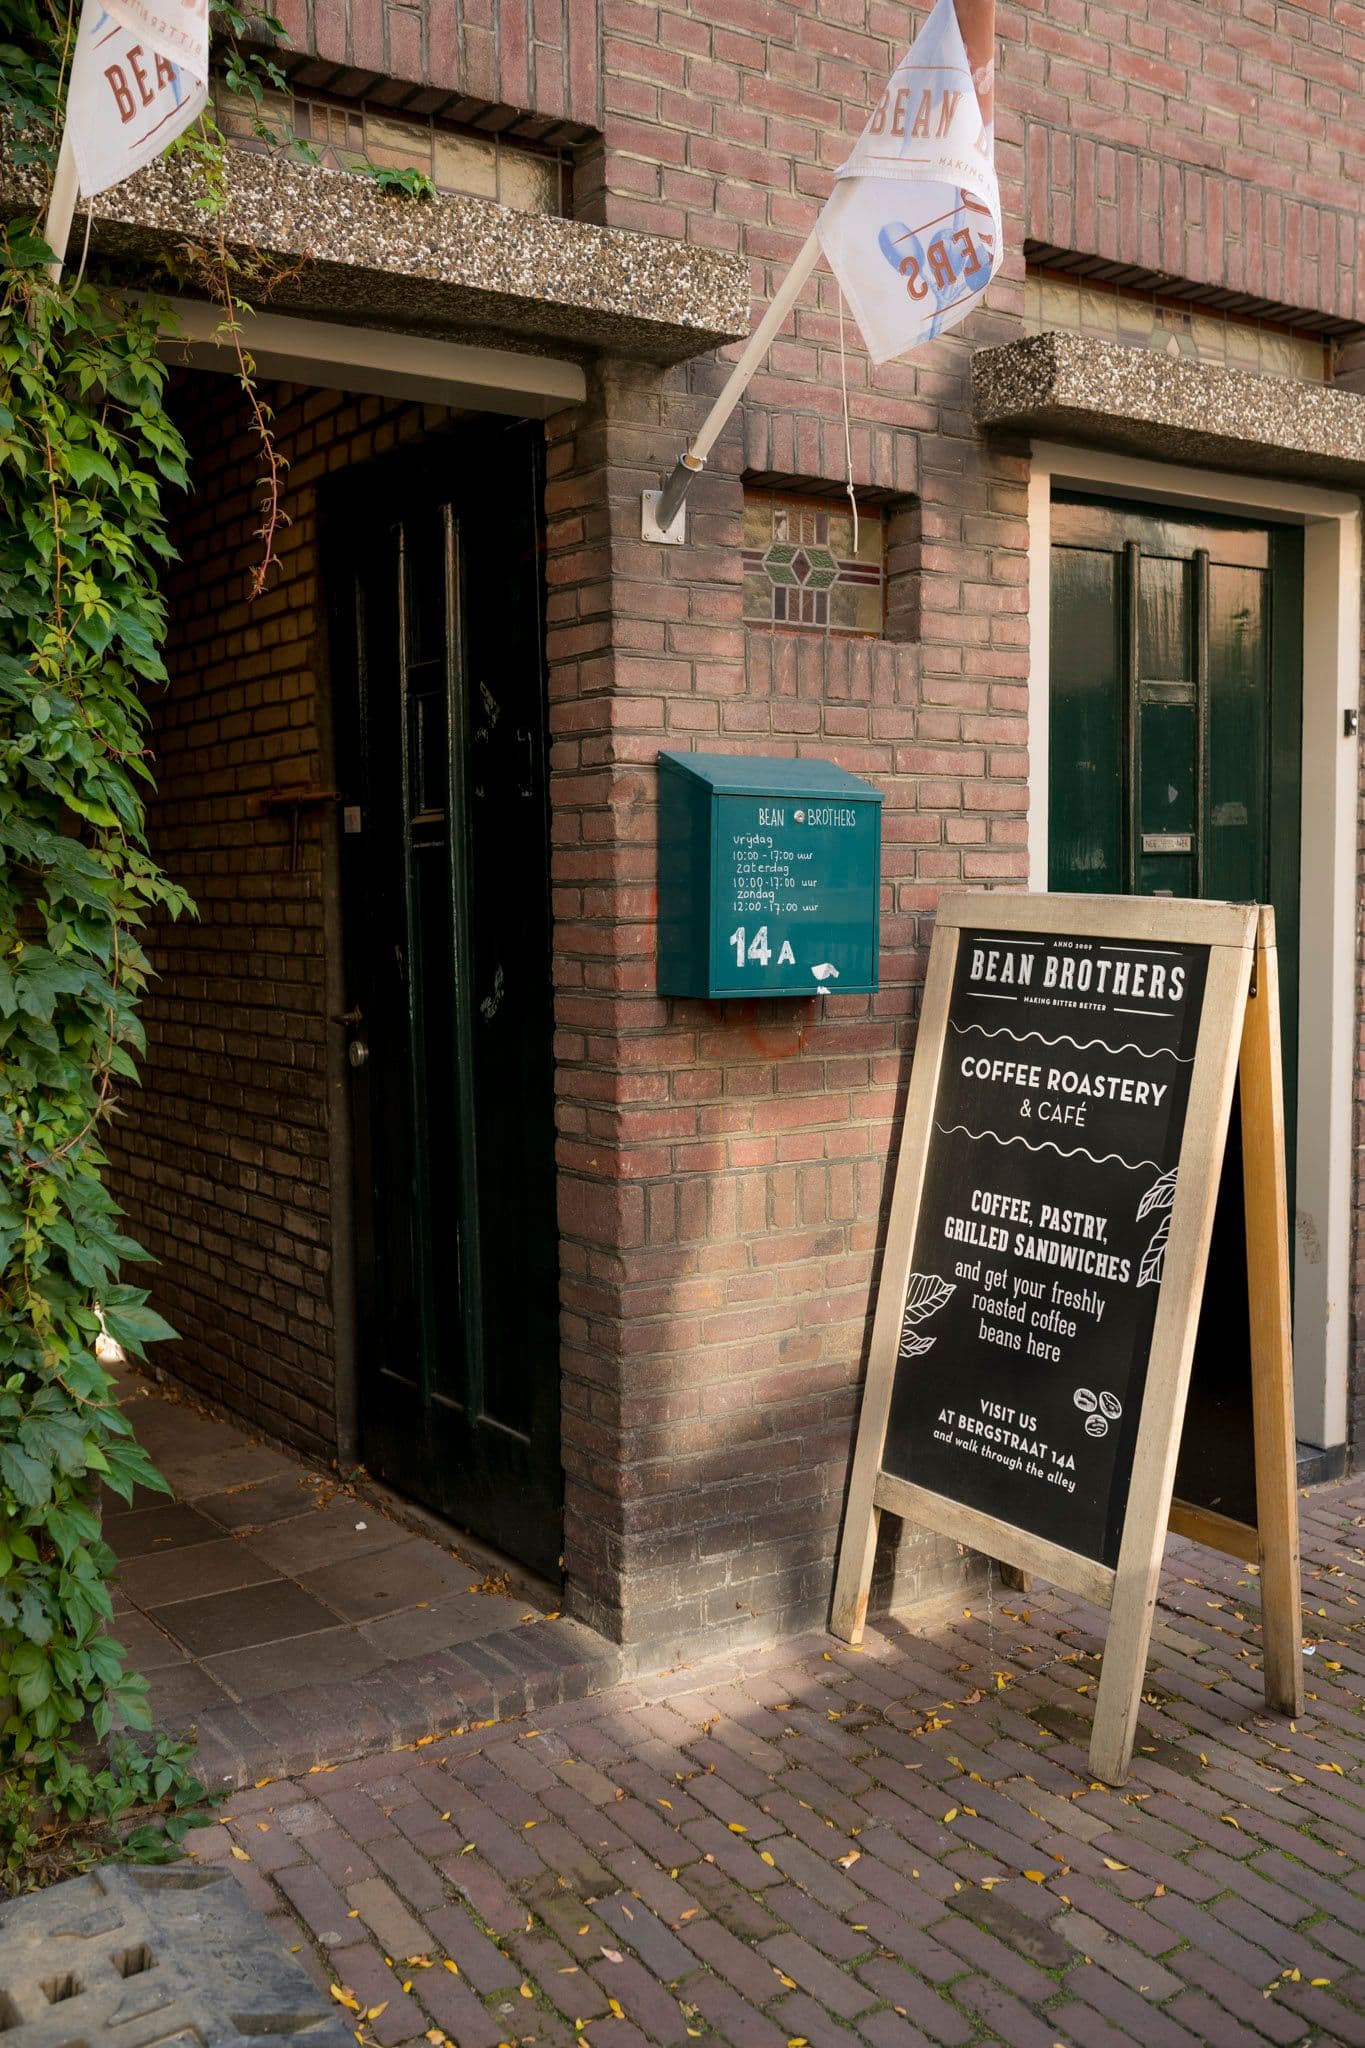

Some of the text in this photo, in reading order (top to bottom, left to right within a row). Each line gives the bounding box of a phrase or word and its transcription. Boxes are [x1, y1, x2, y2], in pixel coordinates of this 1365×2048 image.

[104, 44, 202, 124] BEA
[869, 88, 962, 139] BEAN
[758, 808, 856, 826] BEAN BROTHERS
[736, 863, 789, 876] zaterdag
[798, 852, 813, 860] uur
[737, 890, 775, 902] zondag
[802, 879, 817, 887] uur
[803, 903, 818, 911] uur
[1053, 940, 1074, 948] ANNO
[970, 949, 1186, 1002] BEAN BROTHERS
[1024, 996, 1107, 1012] MAKING BITTER BETTER
[961, 1056, 1168, 1107] COFFEE ROASTERY
[1020, 1098, 1088, 1128] & CAFÉ
[971, 1189, 1109, 1245] COFFEE, PASTRY,
[944, 1217, 1131, 1284] GRILLED SANDWICHES
[955, 1260, 1106, 1322] and get your freshly
[972, 1292, 1077, 1338] roasted coffee
[979, 1318, 1061, 1363] beans here
[980, 1399, 1038, 1432] VISIT US
[933, 1428, 1076, 1493] and walk through the alley
[938, 1408, 1076, 1471] AT BERGSTRAAT 14A
